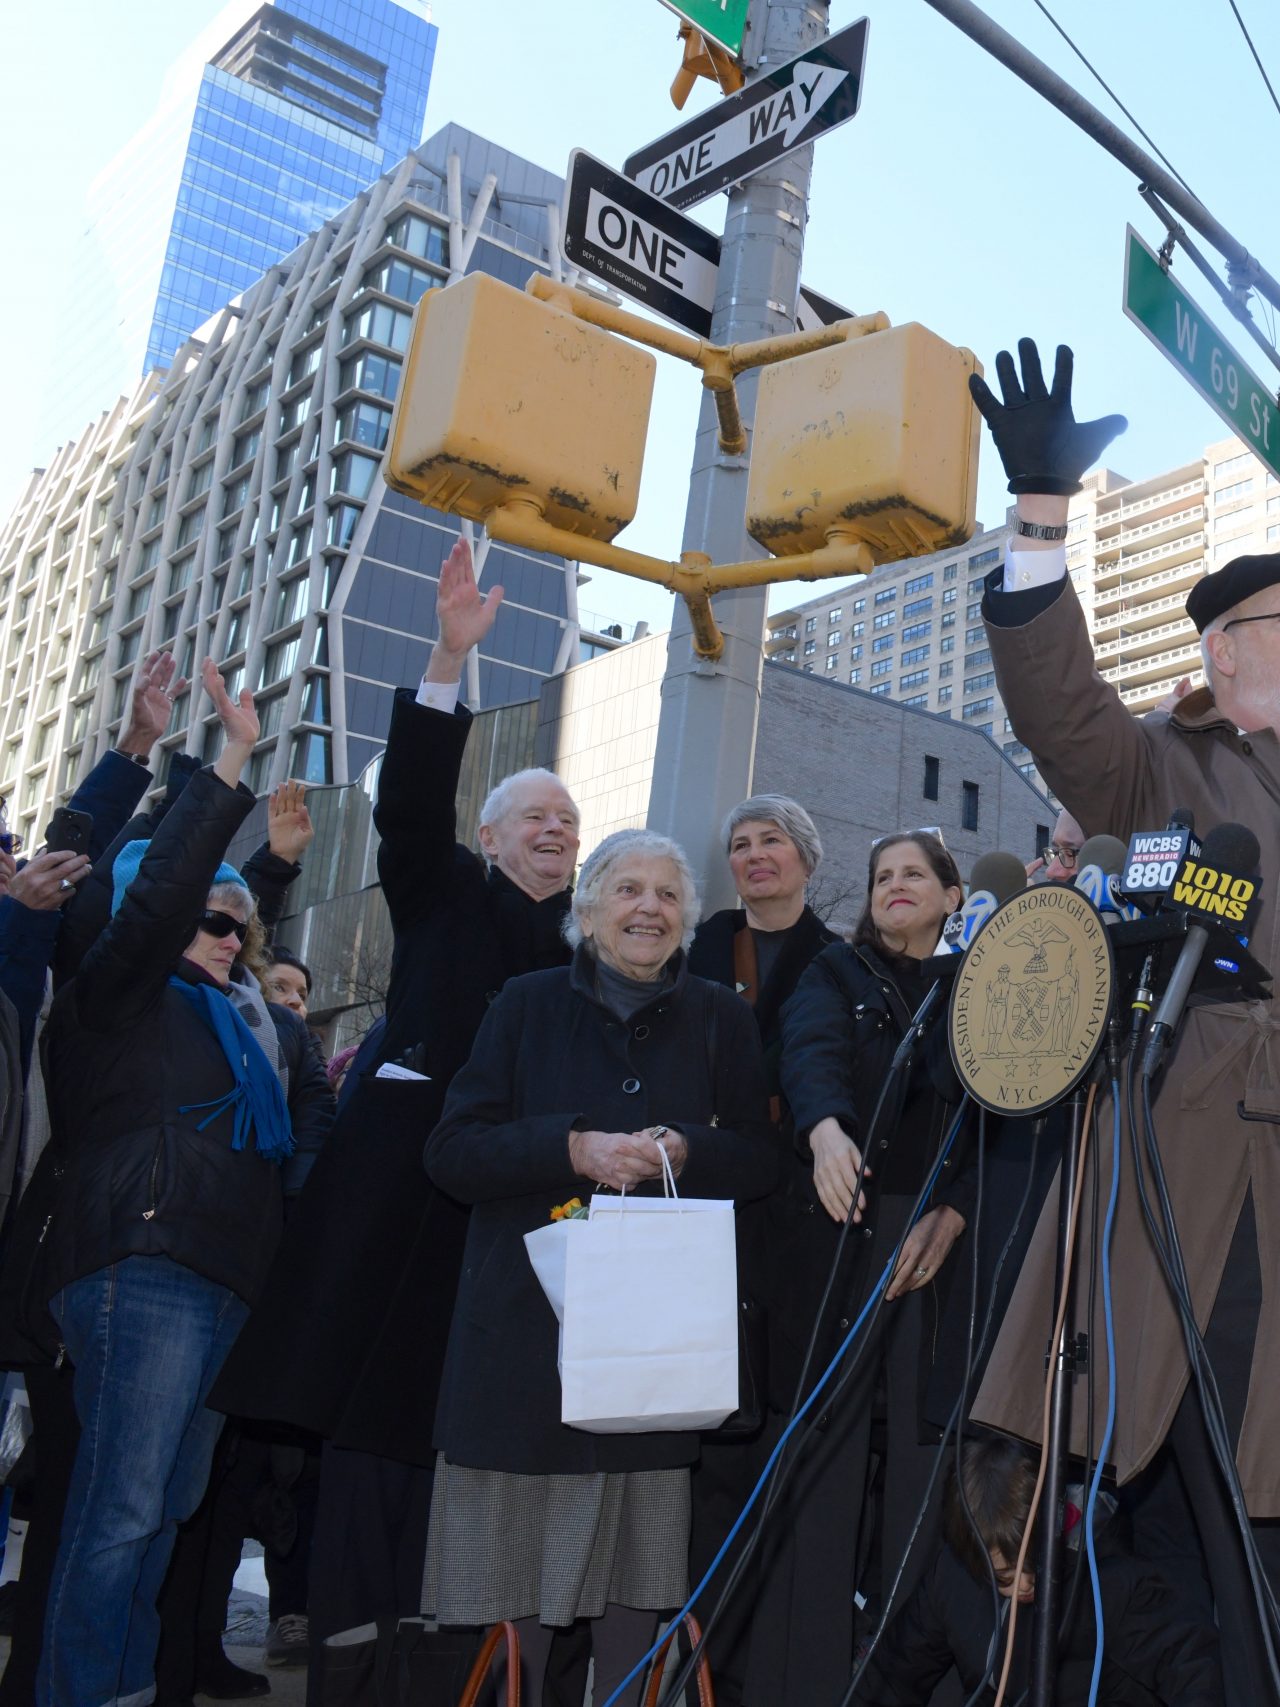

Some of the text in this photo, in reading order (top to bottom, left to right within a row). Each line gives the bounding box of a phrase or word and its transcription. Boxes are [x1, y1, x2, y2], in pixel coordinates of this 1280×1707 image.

[650, 71, 824, 197] ONE WAY
[598, 205, 686, 290] ONE
[606, 264, 647, 292] TRANSPORTATION
[1175, 300, 1271, 450] W 69 St
[1131, 852, 1180, 863] NEWSRADIO
[1134, 835, 1201, 858] WCBS W
[1125, 861, 1178, 888] 880
[1181, 860, 1255, 902] 1010
[1173, 881, 1248, 921] WINS
[943, 918, 964, 935] abc
[956, 892, 1107, 1079] PRESIDENT OF THE BOROUGH OF MANHATTAN
